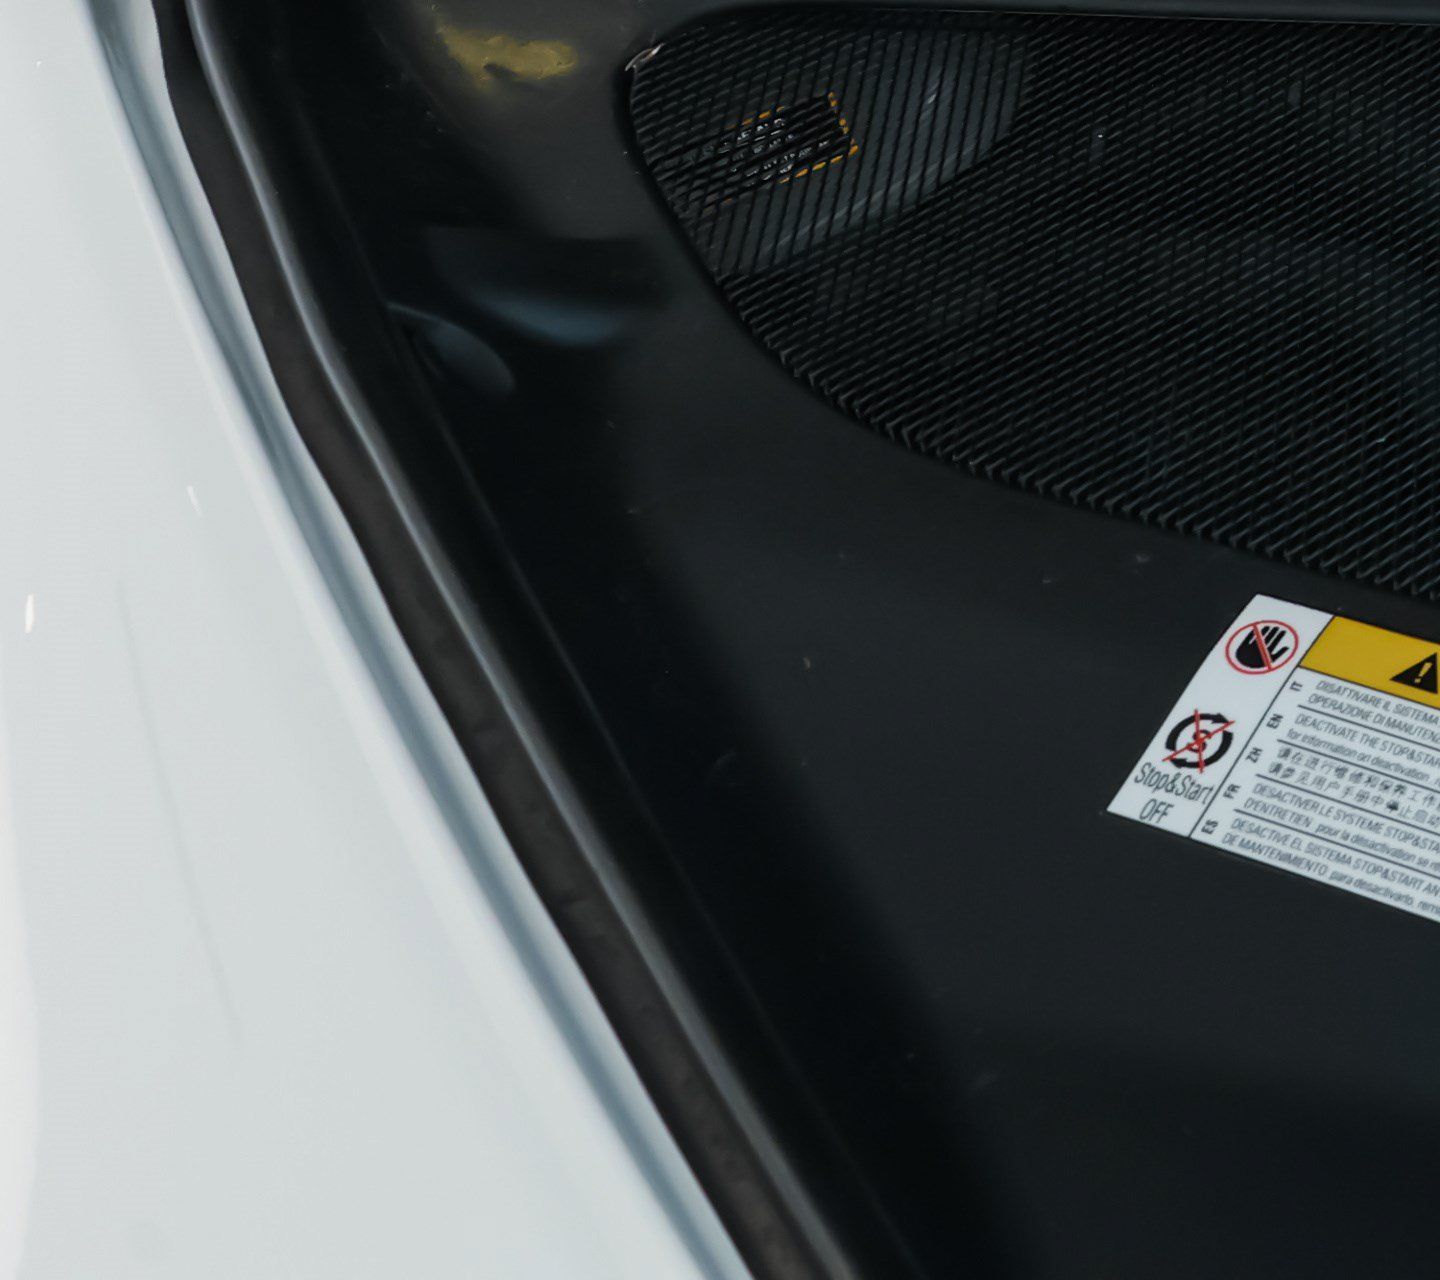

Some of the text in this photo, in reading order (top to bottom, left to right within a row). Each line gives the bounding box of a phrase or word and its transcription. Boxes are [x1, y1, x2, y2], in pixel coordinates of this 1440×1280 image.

[1289, 680, 1303, 692] IT
[1308, 693, 1372, 721] OPERAZIONE
[1372, 713, 1386, 725] DI
[1316, 680, 1382, 708] DISATTIVARE
[1382, 700, 1391, 712] IL
[1393, 704, 1439, 725] SISTEMA
[1266, 714, 1283, 729] EN
[1295, 714, 1358, 741] DEACTIVATE
[1359, 733, 1380, 749] THE
[1246, 747, 1262, 763] ZH
[1134, 762, 1214, 804] Stop&Start
[1223, 784, 1240, 799] FR
[1139, 798, 1174, 823] OFF
[1253, 783, 1320, 812] DESACTIVER
[1318, 805, 1334, 818] LE
[1201, 820, 1218, 835] ES
[1222, 833, 1238, 846] DE
[1289, 837, 1303, 851] EL
[1305, 842, 1352, 865] SISTEMA
[1353, 858, 1424, 890] STOP&START
